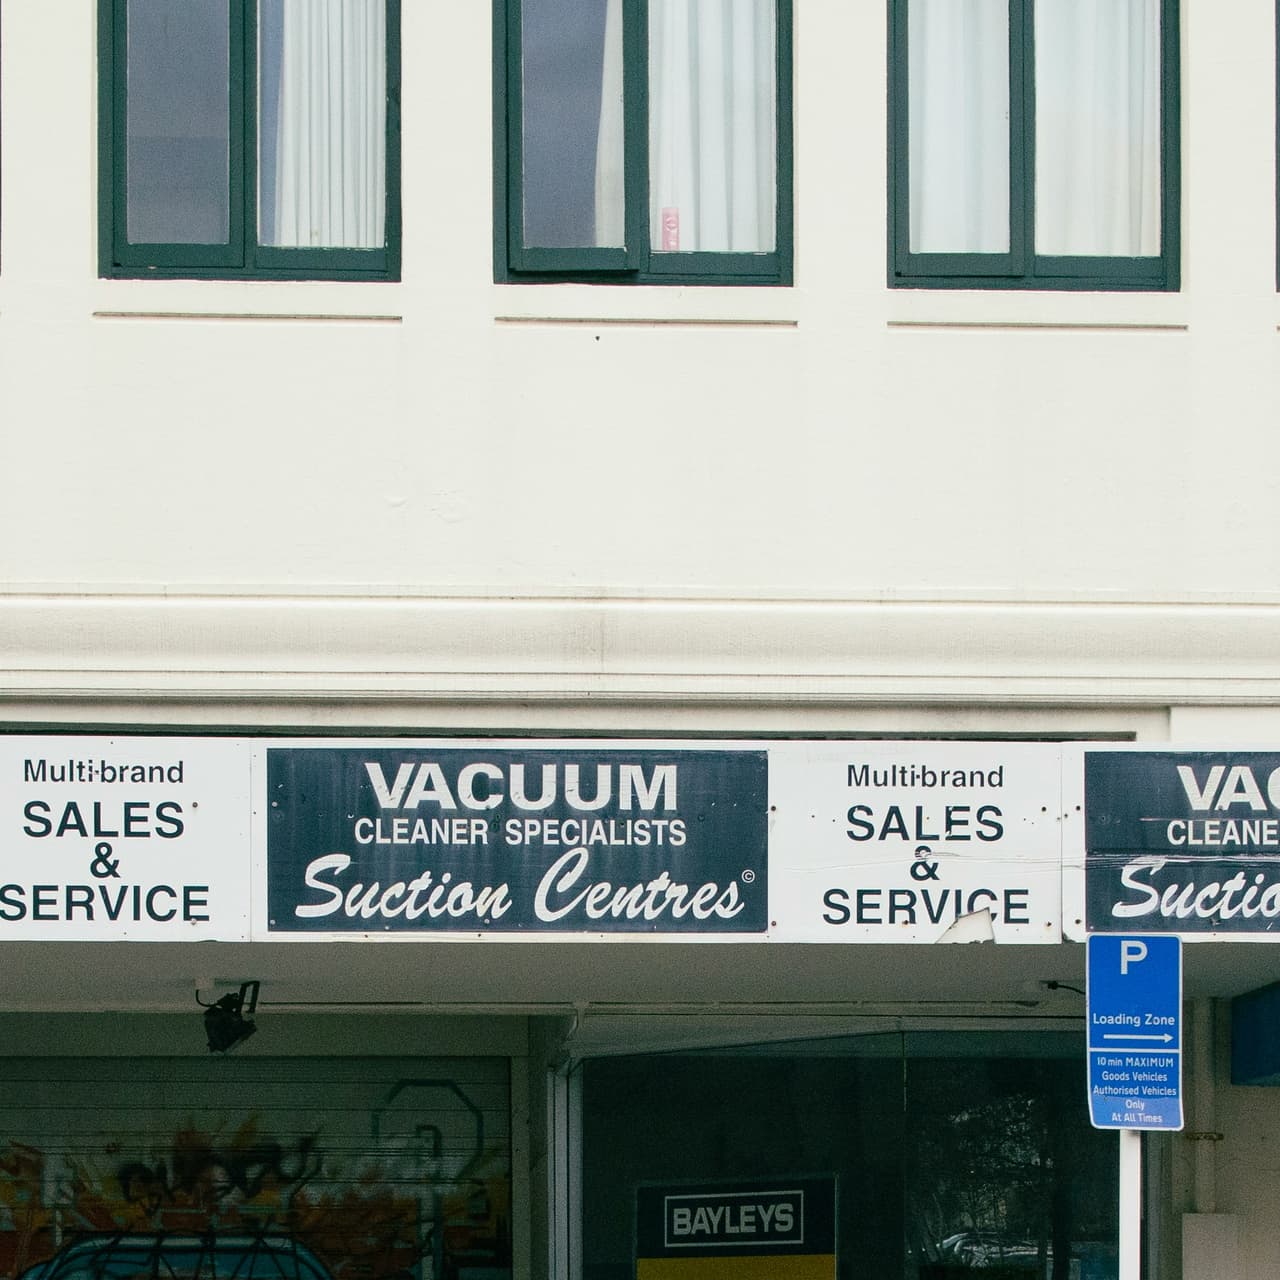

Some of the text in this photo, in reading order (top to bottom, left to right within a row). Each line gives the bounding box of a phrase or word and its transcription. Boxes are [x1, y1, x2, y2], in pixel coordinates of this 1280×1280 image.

[364, 763, 677, 811] VACUUM
[23, 801, 184, 838] SALES
[354, 818, 686, 846] CLEANER SPECIALISTS
[846, 805, 1004, 842] SALES
[89, 843, 120, 879] &
[910, 845, 940, 881] &
[296, 853, 512, 919] Suction
[823, 888, 1029, 925] SERVICE
[1121, 940, 1148, 975] P
[1093, 1013, 1175, 1027] Loading Zone
[1097, 1057, 1174, 1067] 10 min MAXIMUM
[1102, 1071, 1168, 1081] Goods Vehicles
[1093, 1085, 1176, 1096] Authorised Vehicles
[1125, 1099, 1145, 1110] Only
[1112, 1112, 1163, 1122] At All Times
[673, 1203, 794, 1236] BAYLEYS
